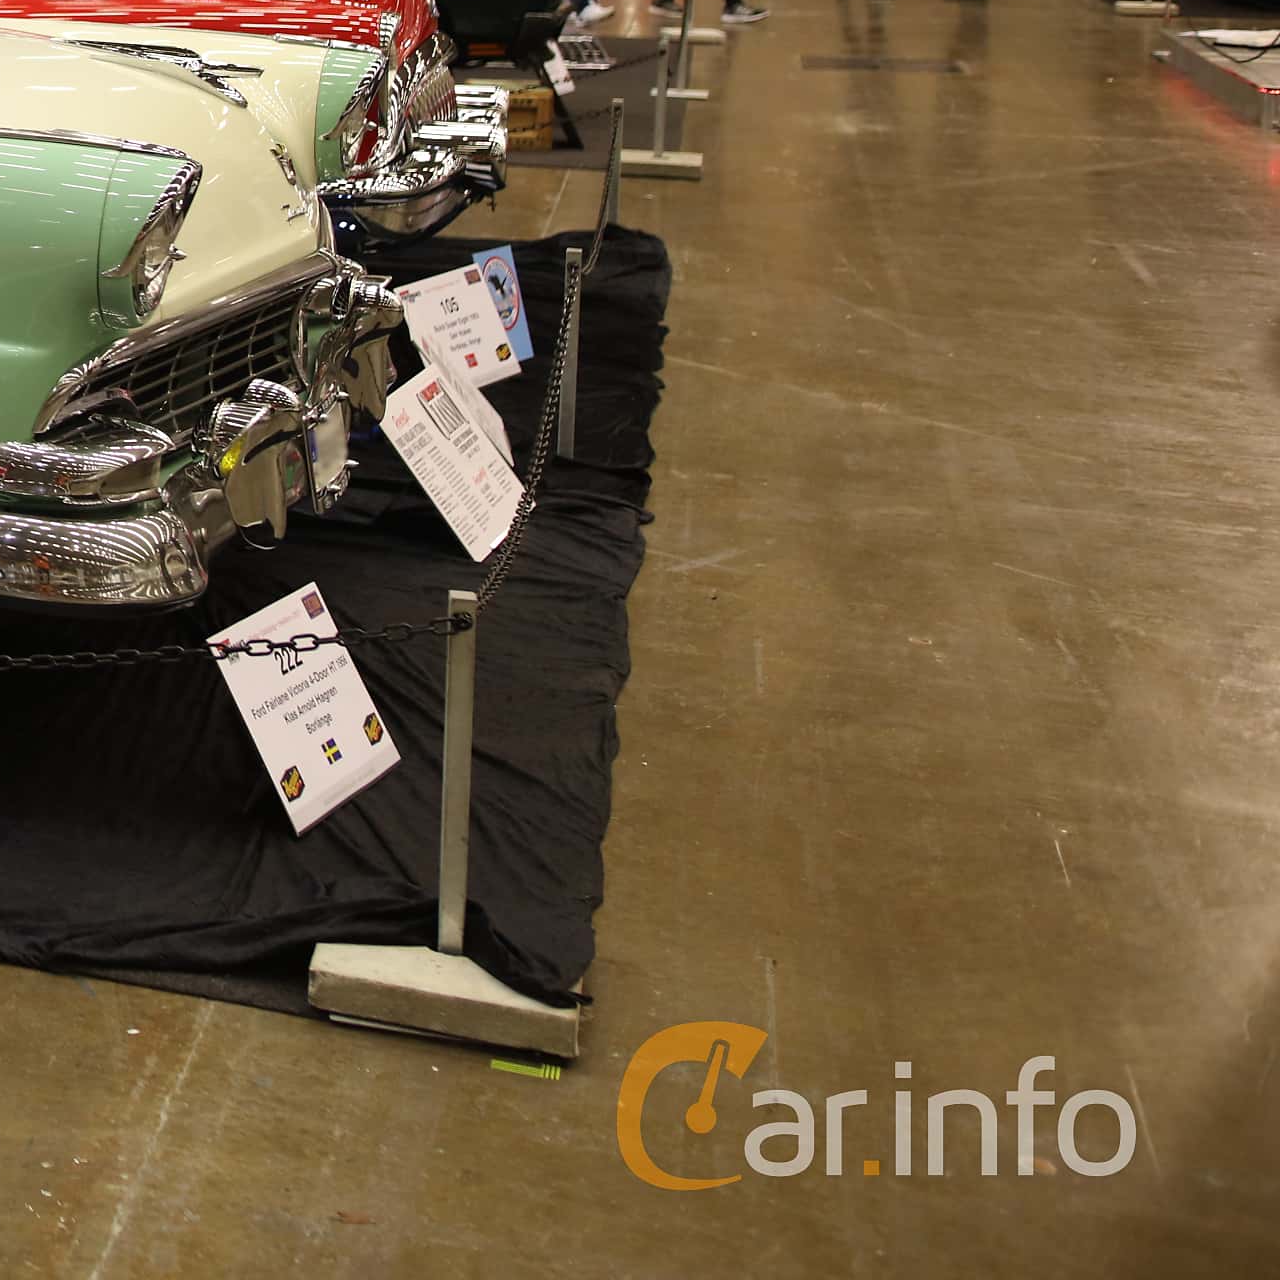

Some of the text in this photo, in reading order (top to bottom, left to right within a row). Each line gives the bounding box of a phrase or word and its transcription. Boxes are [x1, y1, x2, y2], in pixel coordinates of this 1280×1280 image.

[440, 296, 460, 316] 105
[274, 645, 303, 676] 222
[251, 704, 267, 720] Ford
[264, 693, 290, 713] Fairlane
[287, 679, 310, 698] Victoria
